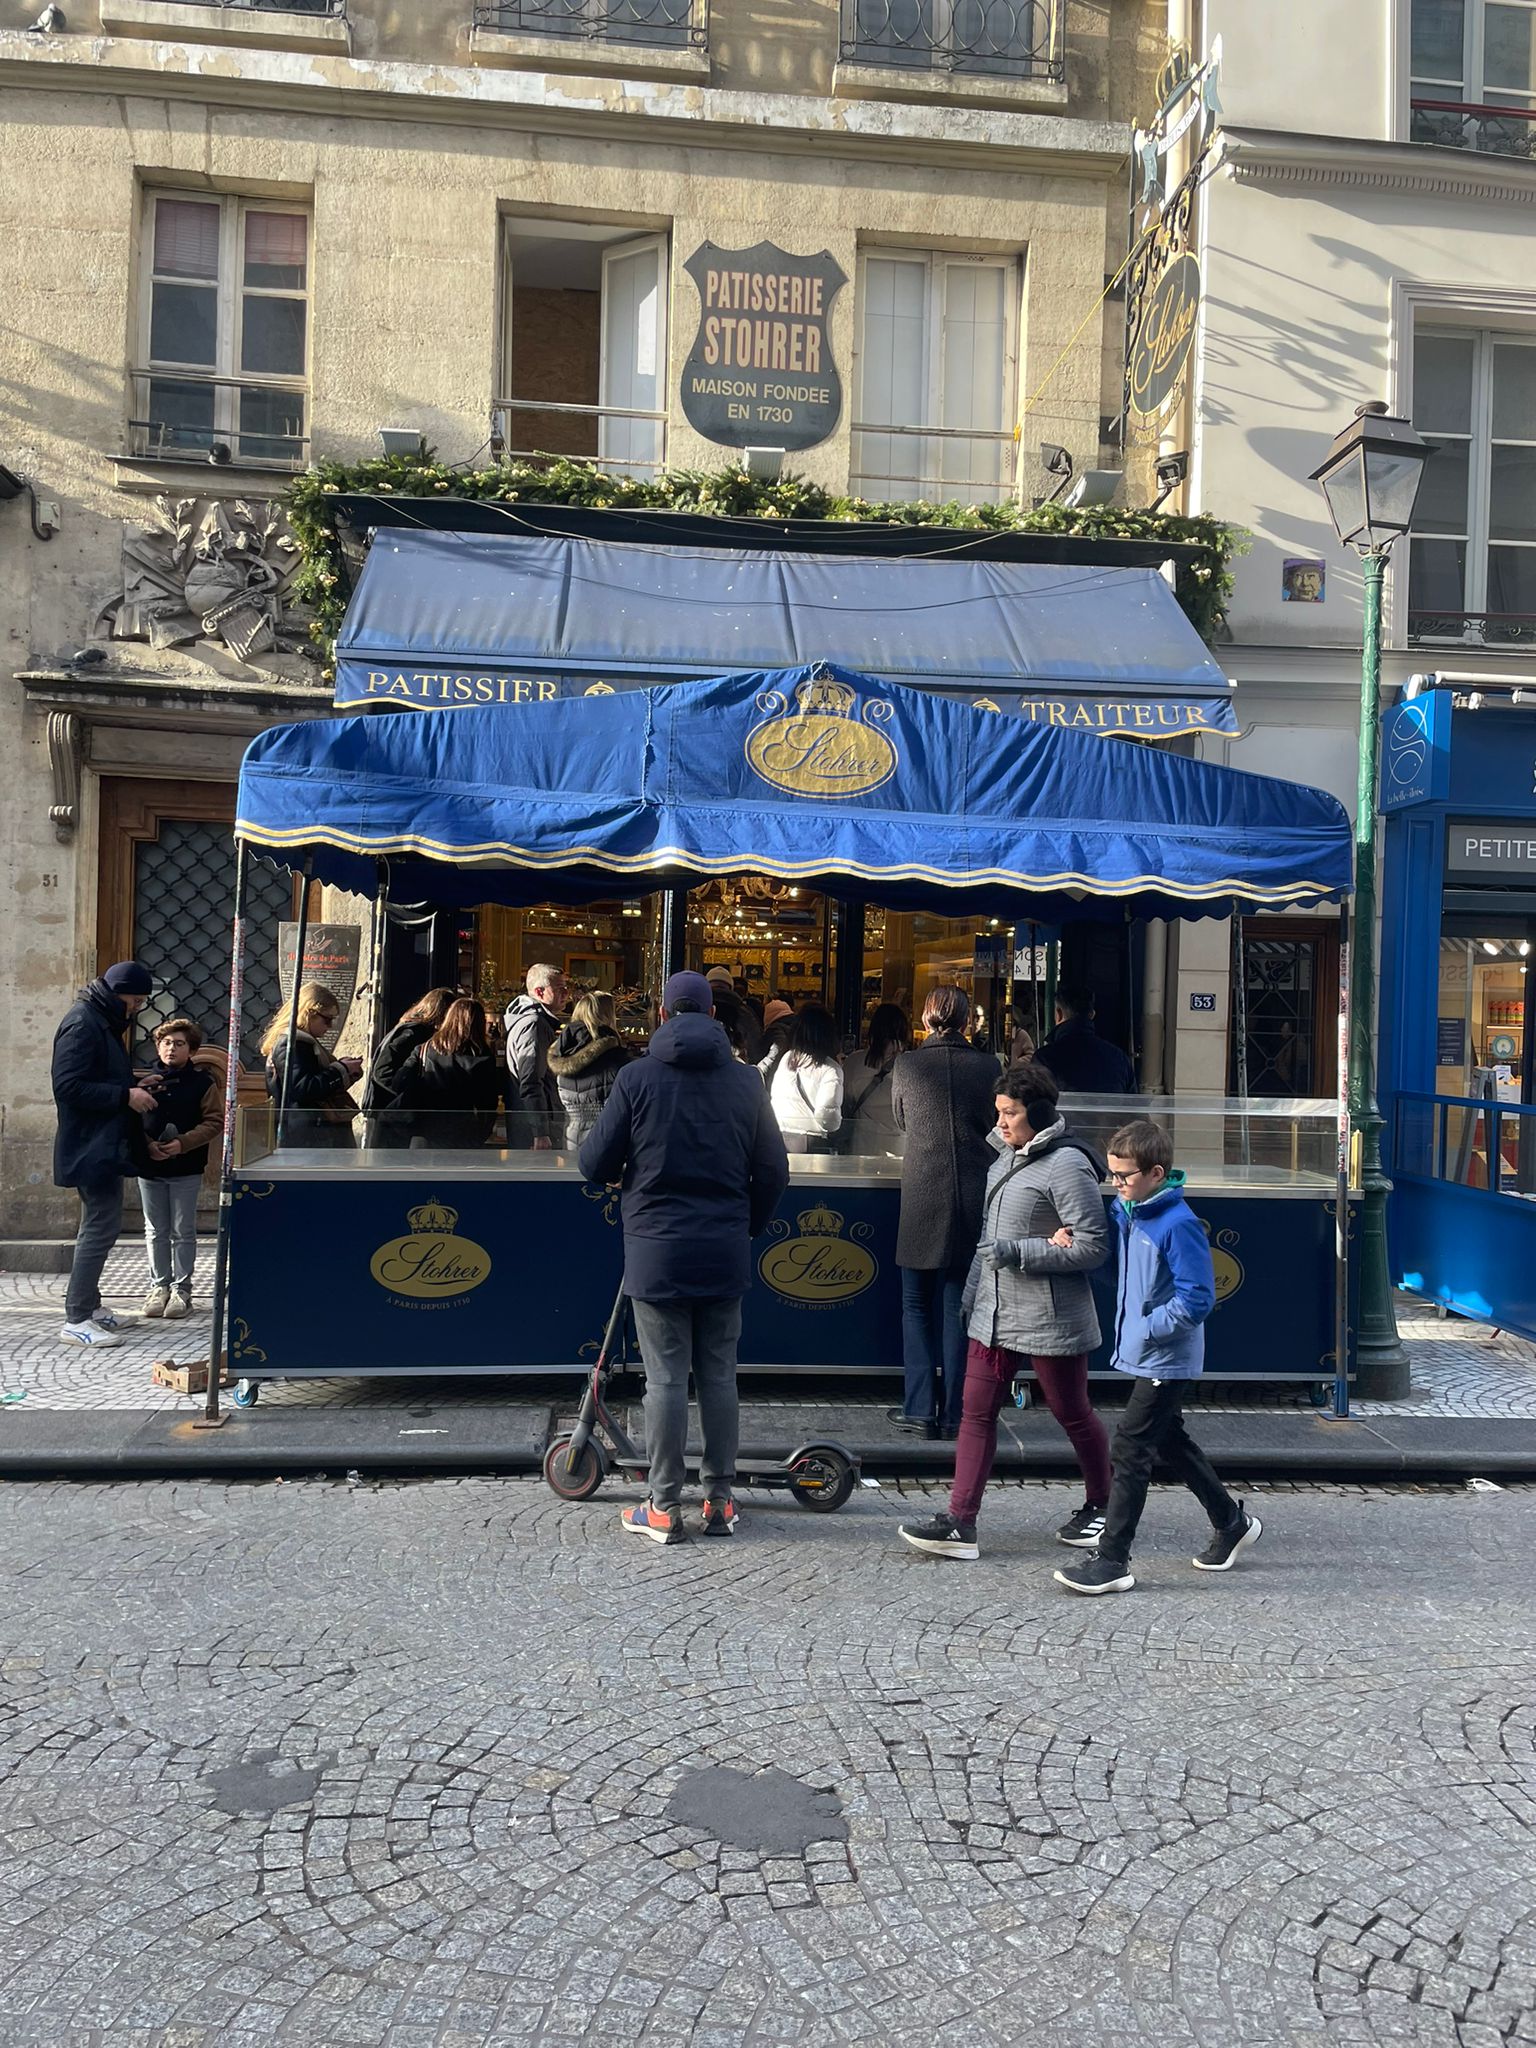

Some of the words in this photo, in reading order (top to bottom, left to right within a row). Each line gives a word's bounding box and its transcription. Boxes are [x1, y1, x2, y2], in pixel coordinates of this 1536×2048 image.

[706, 270, 824, 316] PATISSERIE
[704, 316, 821, 373] STOHRER
[1134, 284, 1197, 395] Stohrer
[692, 378, 757, 398] MAISON
[763, 383, 830, 404] FONDEE
[727, 403, 750, 419] EN
[757, 405, 793, 423] 1730
[365, 671, 557, 703] PATISSIER
[1021, 700, 1208, 727] TRAITEUR
[762, 723, 882, 777] Stohrer
[1465, 838, 1536, 859] PETITE
[43, 874, 58, 888] 51
[1194, 996, 1212, 1008] 53
[381, 1241, 481, 1284] Stohrer
[772, 1244, 865, 1285] Stohrer
[394, 1299, 418, 1309] PARIS
[421, 1302, 450, 1310] DEPUIS
